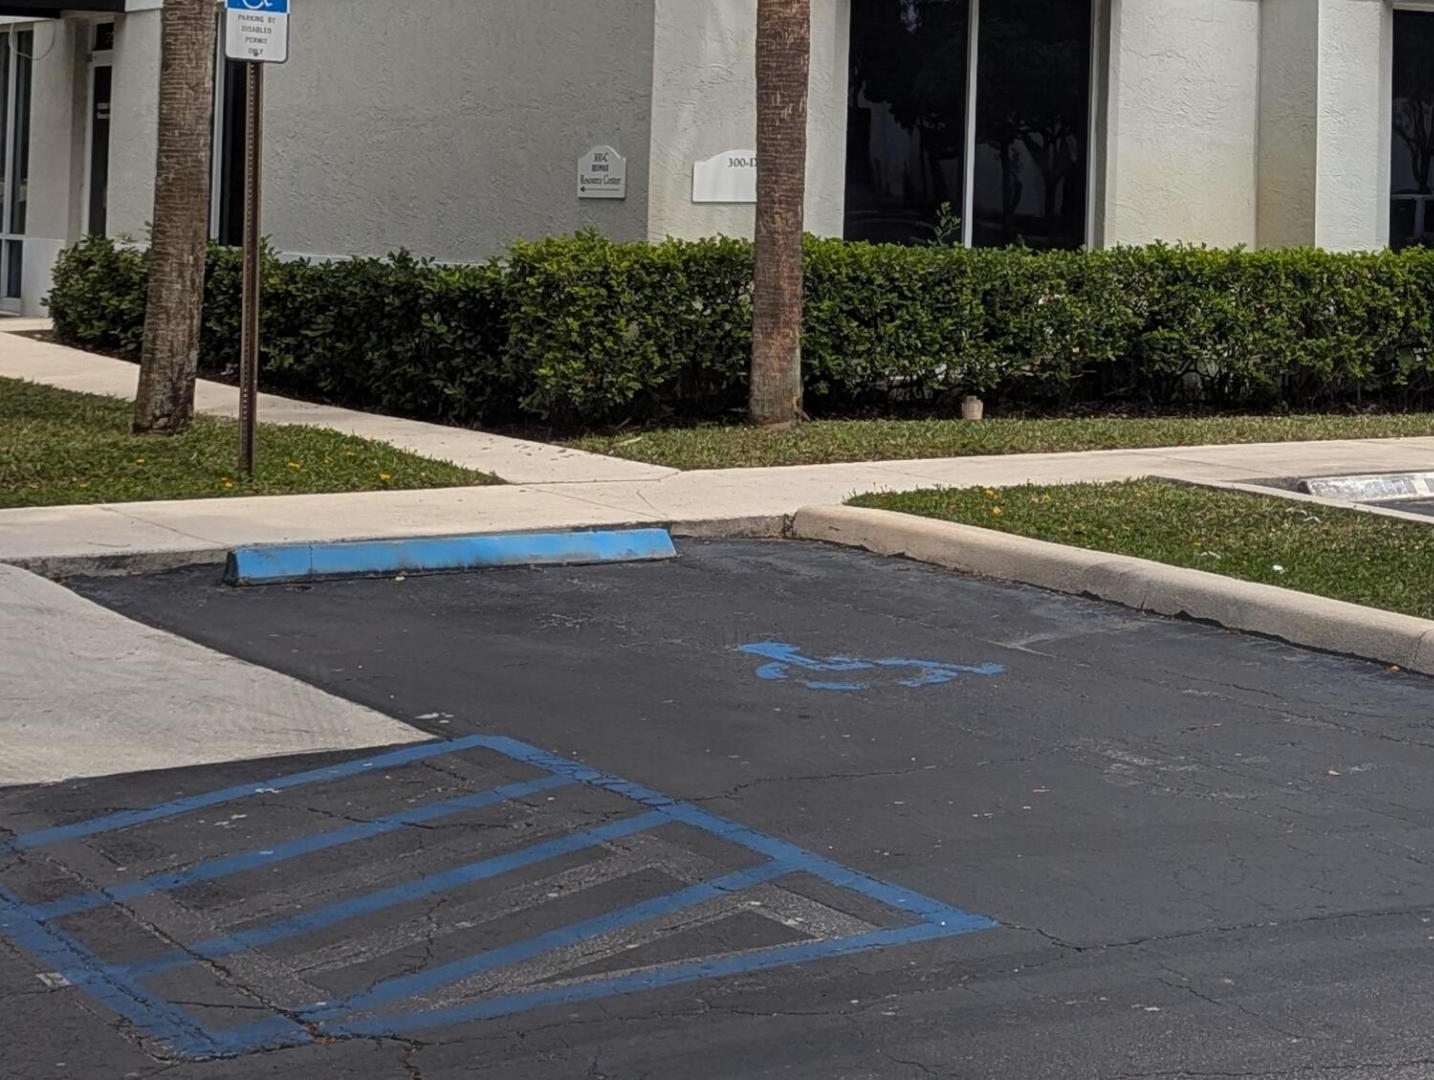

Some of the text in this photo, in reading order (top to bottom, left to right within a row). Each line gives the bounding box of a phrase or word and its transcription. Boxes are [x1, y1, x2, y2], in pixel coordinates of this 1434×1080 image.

[238, 14, 264, 23] PARKING
[241, 25, 272, 34] DISABLED
[245, 36, 267, 44] PERMIT
